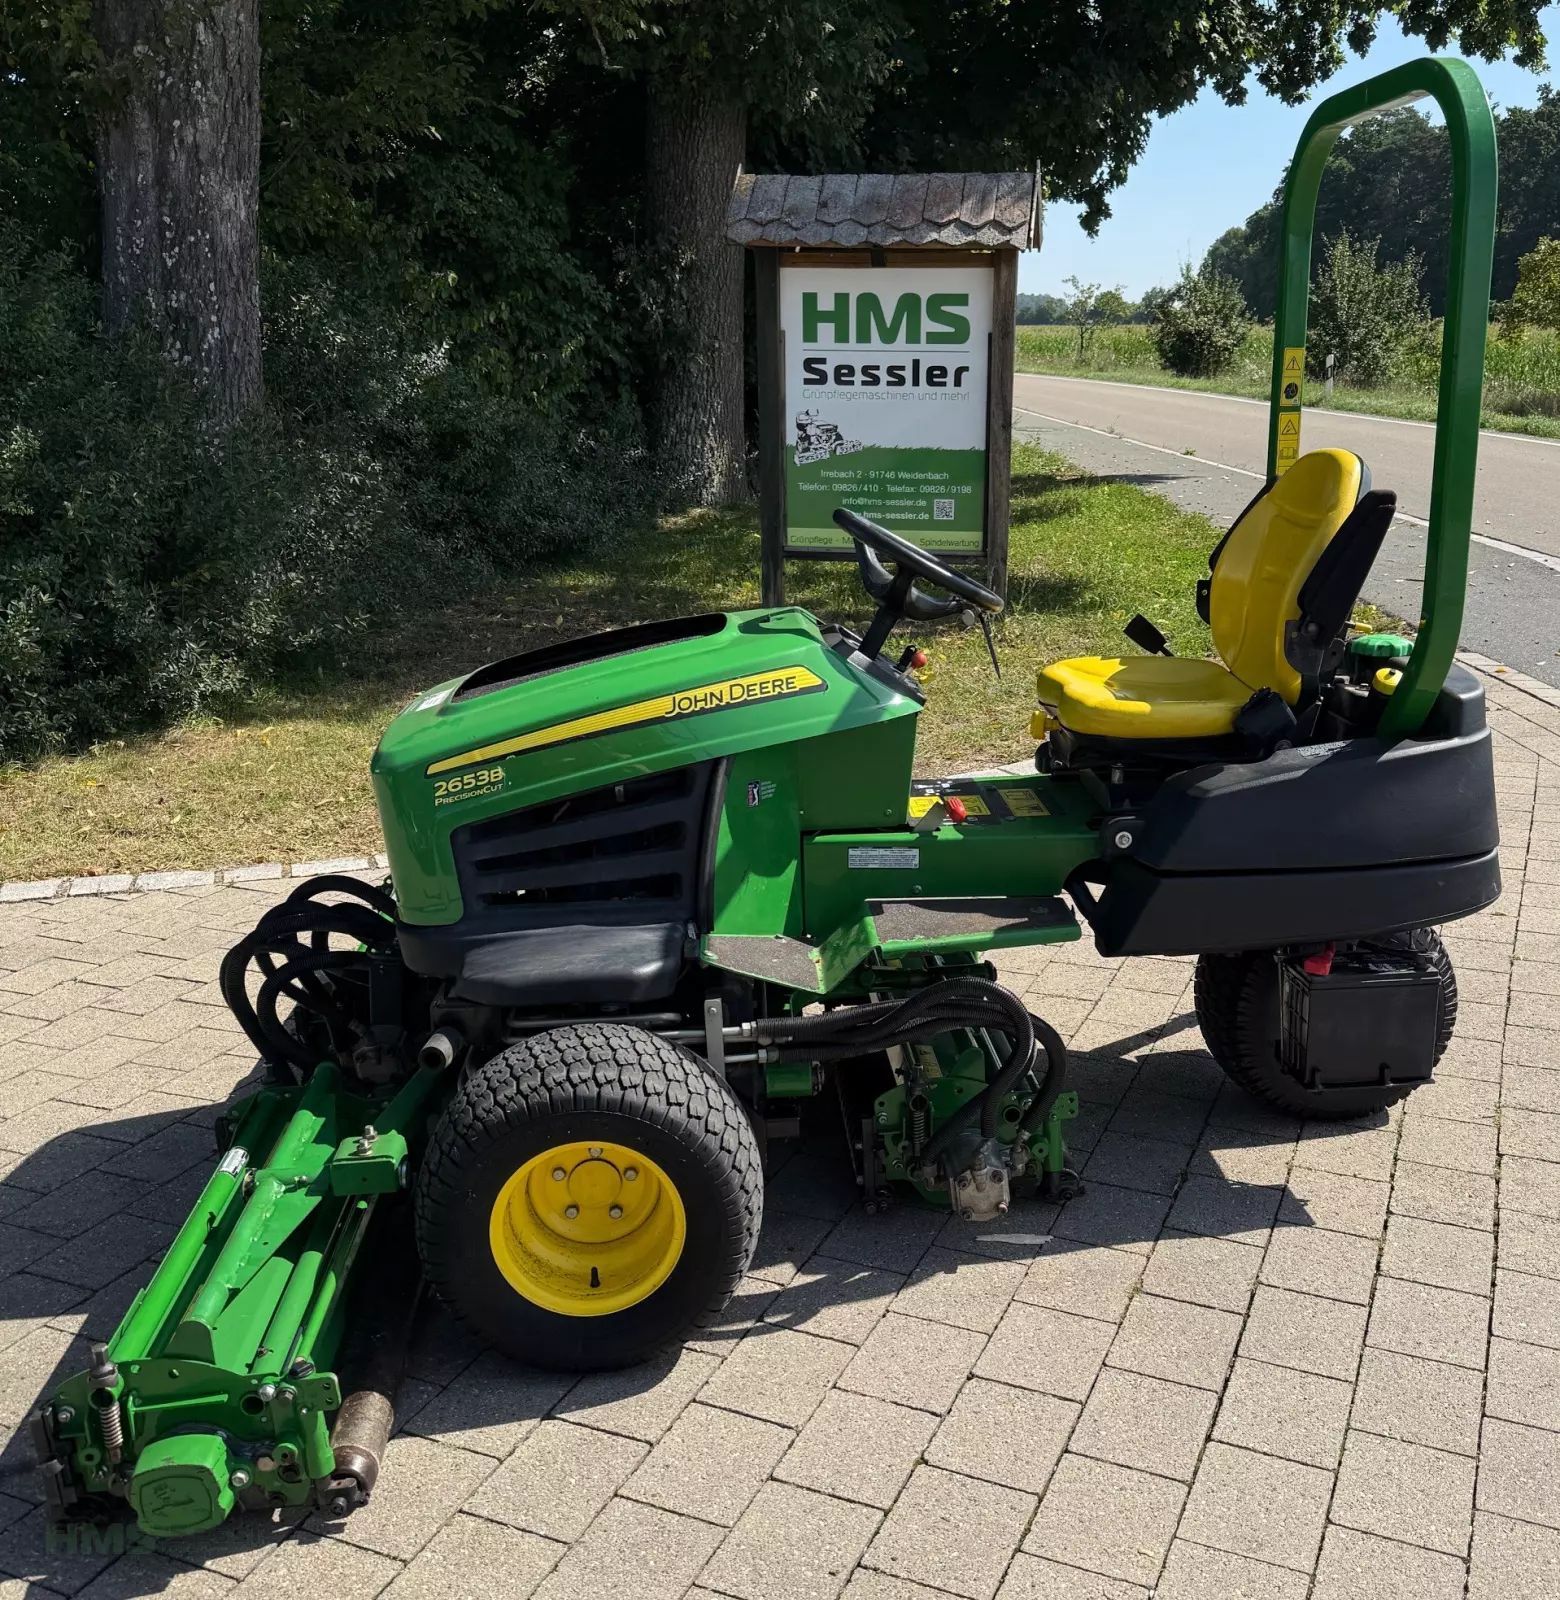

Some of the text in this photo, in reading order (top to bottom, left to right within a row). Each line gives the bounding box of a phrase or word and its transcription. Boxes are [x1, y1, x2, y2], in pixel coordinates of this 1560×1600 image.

[802, 292, 971, 345] HMS
[803, 357, 969, 387] Sessler
[918, 391, 937, 401] und
[821, 469, 949, 480] Irrebach 2 91746 Weidenbach
[798, 483, 830, 491] Telefon:
[842, 497, 927, 507] info@hms-sessler.de
[919, 538, 980, 549] Spindelwartung
[665, 676, 797, 716] JOHN DEERE
[434, 767, 504, 797] 2653B
